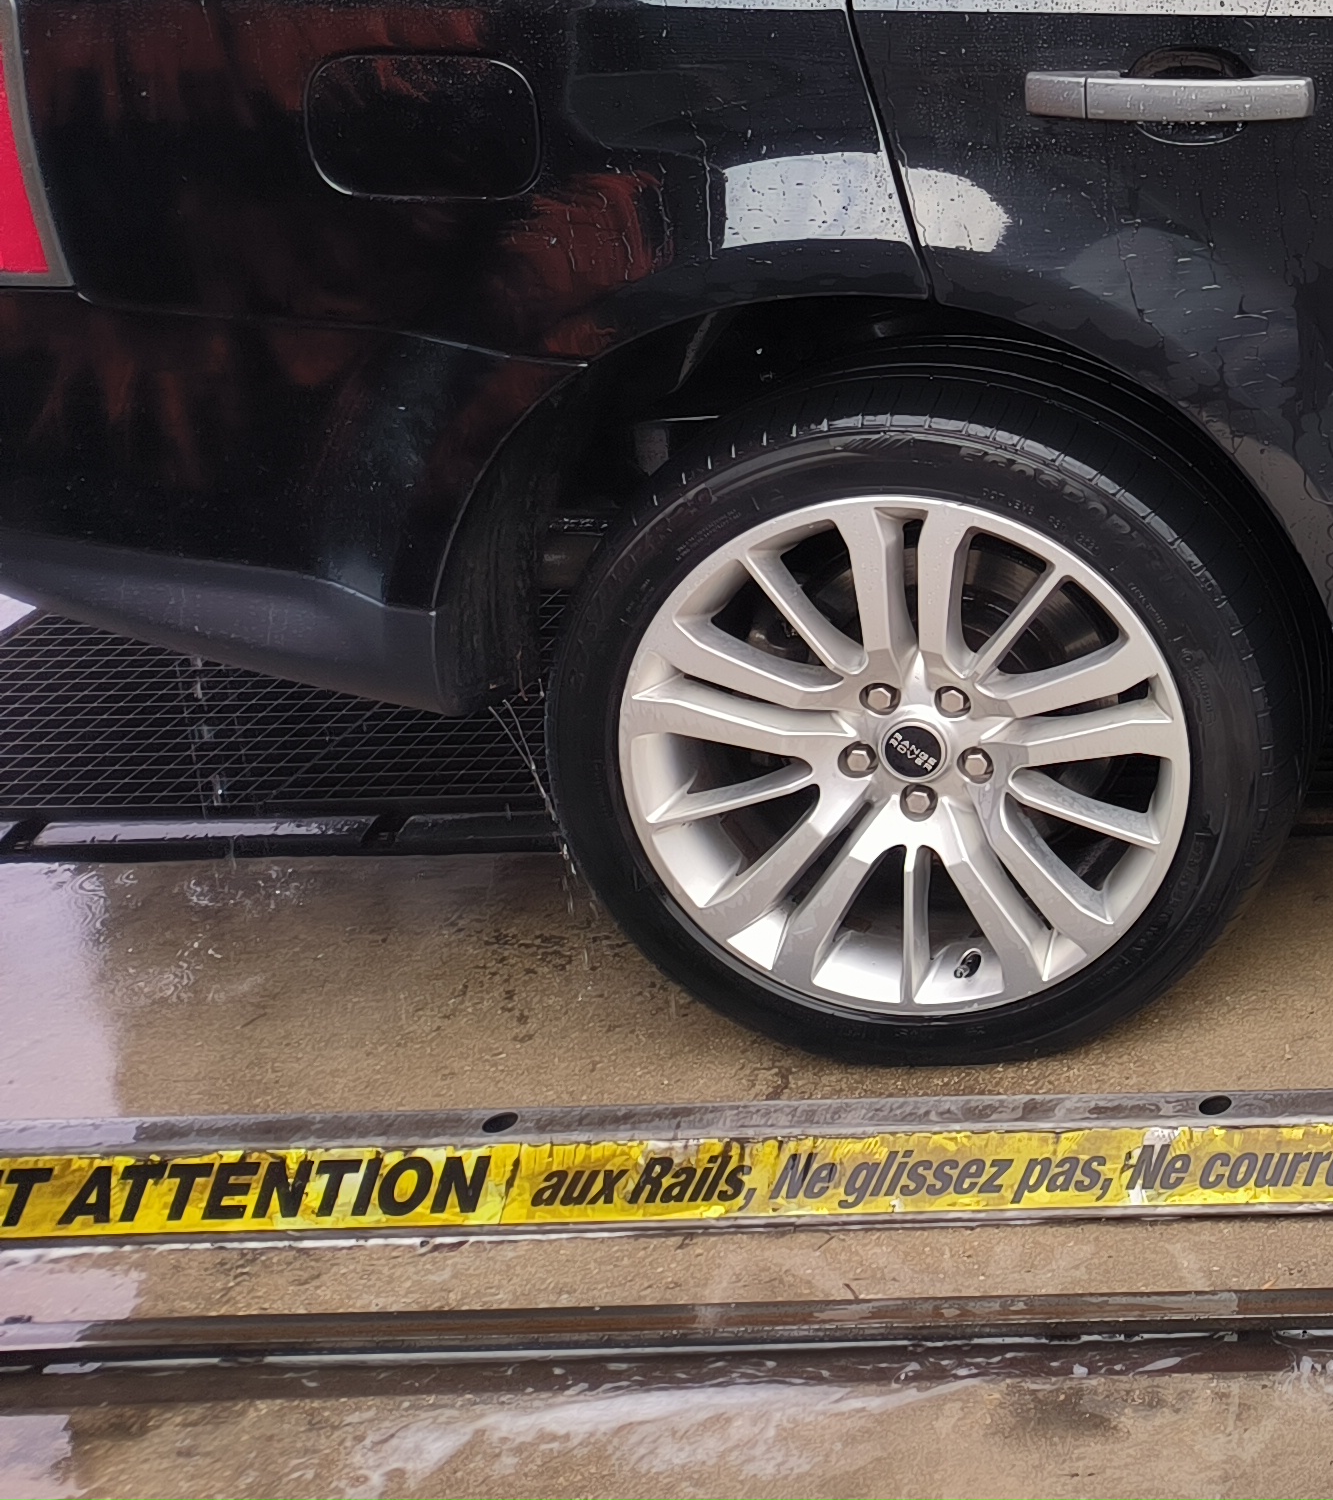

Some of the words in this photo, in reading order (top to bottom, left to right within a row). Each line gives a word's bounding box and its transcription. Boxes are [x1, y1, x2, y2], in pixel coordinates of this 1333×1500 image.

[889, 740, 933, 771] ROVER
[892, 732, 937, 766] RANGE
[57, 1154, 491, 1226] ATTENTION
[530, 1168, 629, 1207] aux
[628, 1150, 758, 1211] Rails,
[769, 1152, 836, 1200] Ne
[838, 1149, 1015, 1209] glissez
[1010, 1154, 1115, 1205] pas,
[1126, 1144, 1191, 1191] Ne
